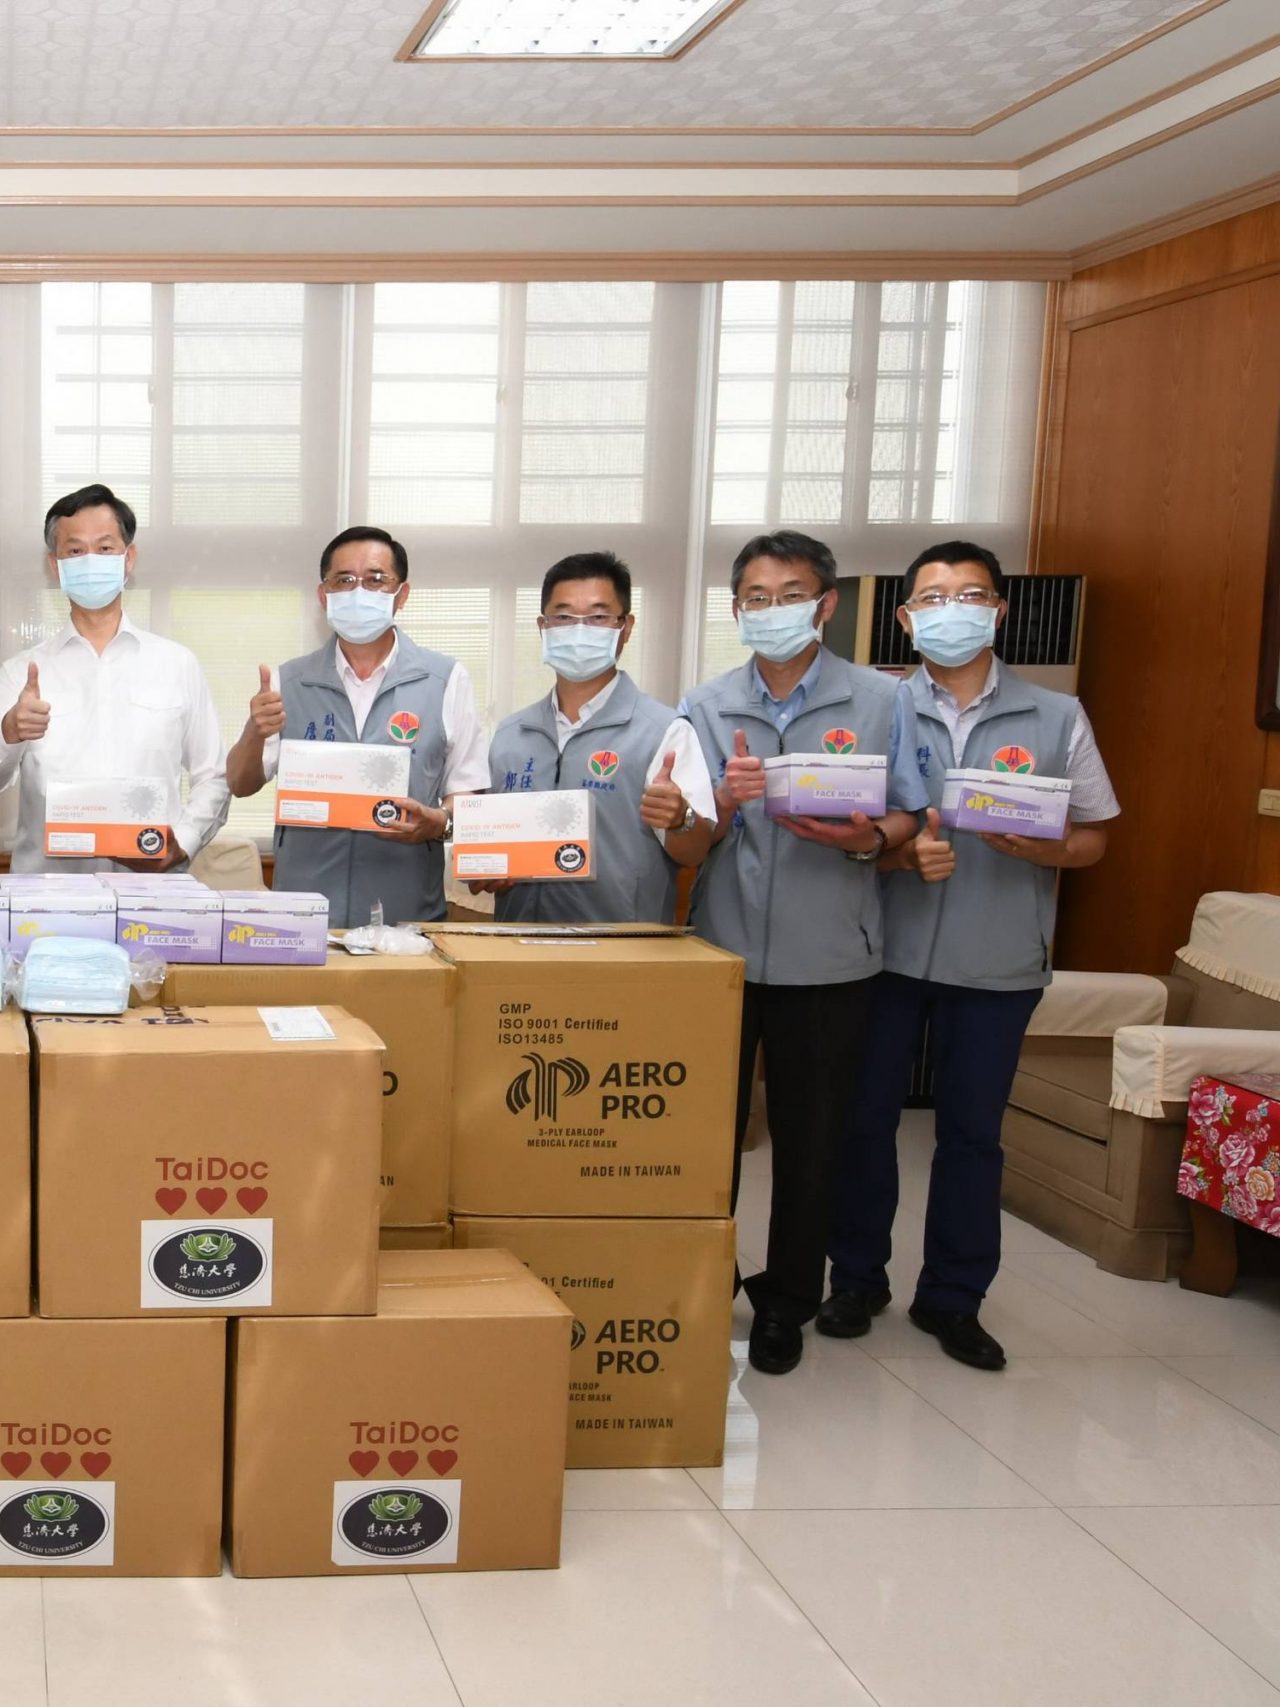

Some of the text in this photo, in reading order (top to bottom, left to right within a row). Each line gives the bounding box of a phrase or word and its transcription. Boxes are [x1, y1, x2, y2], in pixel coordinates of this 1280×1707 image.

[991, 808, 1044, 819] FACE MASK
[147, 936, 199, 945] FACE MASK
[253, 938, 305, 946] FACE MASK
[500, 1003, 532, 1014] GMP
[499, 1018, 619, 1031] ISO 9001 Certified
[498, 1033, 564, 1044] ISO13485
[599, 1061, 687, 1088] AERO
[601, 1094, 666, 1120] PRO
[538, 1128, 605, 1137] 3-PLY EARLOOP
[527, 1139, 618, 1149] MEDICAL FACE MASK
[155, 1157, 269, 1181] TaiDoc
[580, 1165, 681, 1177] MADE IN TAIWAN
[179, 1262, 237, 1279] 慈濟大學
[174, 1281, 241, 1295] TZU CHI UNIVERSITY
[562, 1276, 614, 1289] Certified
[594, 1318, 680, 1344] AERO
[596, 1350, 659, 1374] PRO
[569, 1394, 612, 1402] ACE MASK
[576, 1418, 673, 1430] MADE IN TAIWAN
[0, 1422, 112, 1446] TaiDoc
[349, 1421, 460, 1444] TaiDoc
[23, 1522, 79, 1538] 慈濟大學
[366, 1521, 423, 1538] 慈濟大學
[18, 1541, 84, 1554] TZU CHI UNIVERSITY
[361, 1539, 427, 1554] TZU CHI UNIVERSITY
